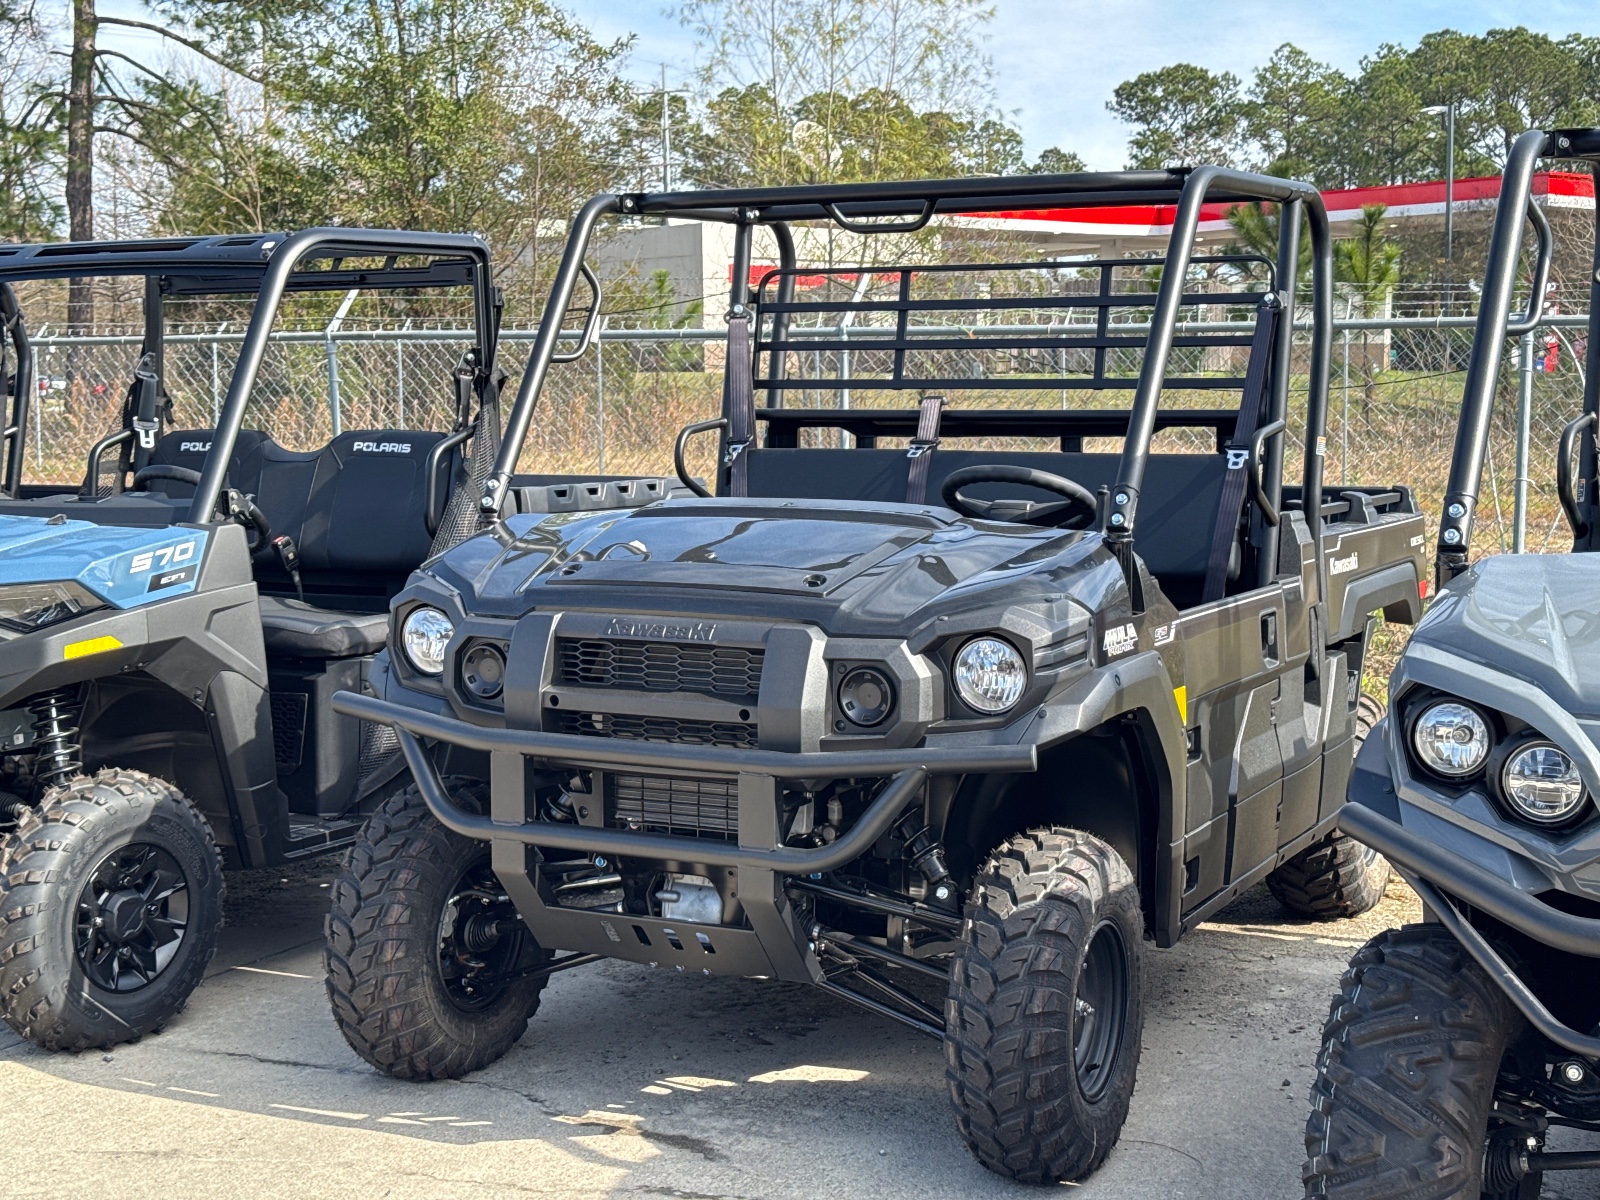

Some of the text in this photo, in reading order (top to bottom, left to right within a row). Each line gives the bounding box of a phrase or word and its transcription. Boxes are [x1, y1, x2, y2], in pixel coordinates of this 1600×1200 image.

[180, 441, 213, 452] POLA
[352, 441, 412, 453] POLARIS
[129, 541, 196, 574] 570
[1330, 552, 1358, 576] Kawasaki
[603, 618, 717, 641] Kawasaki
